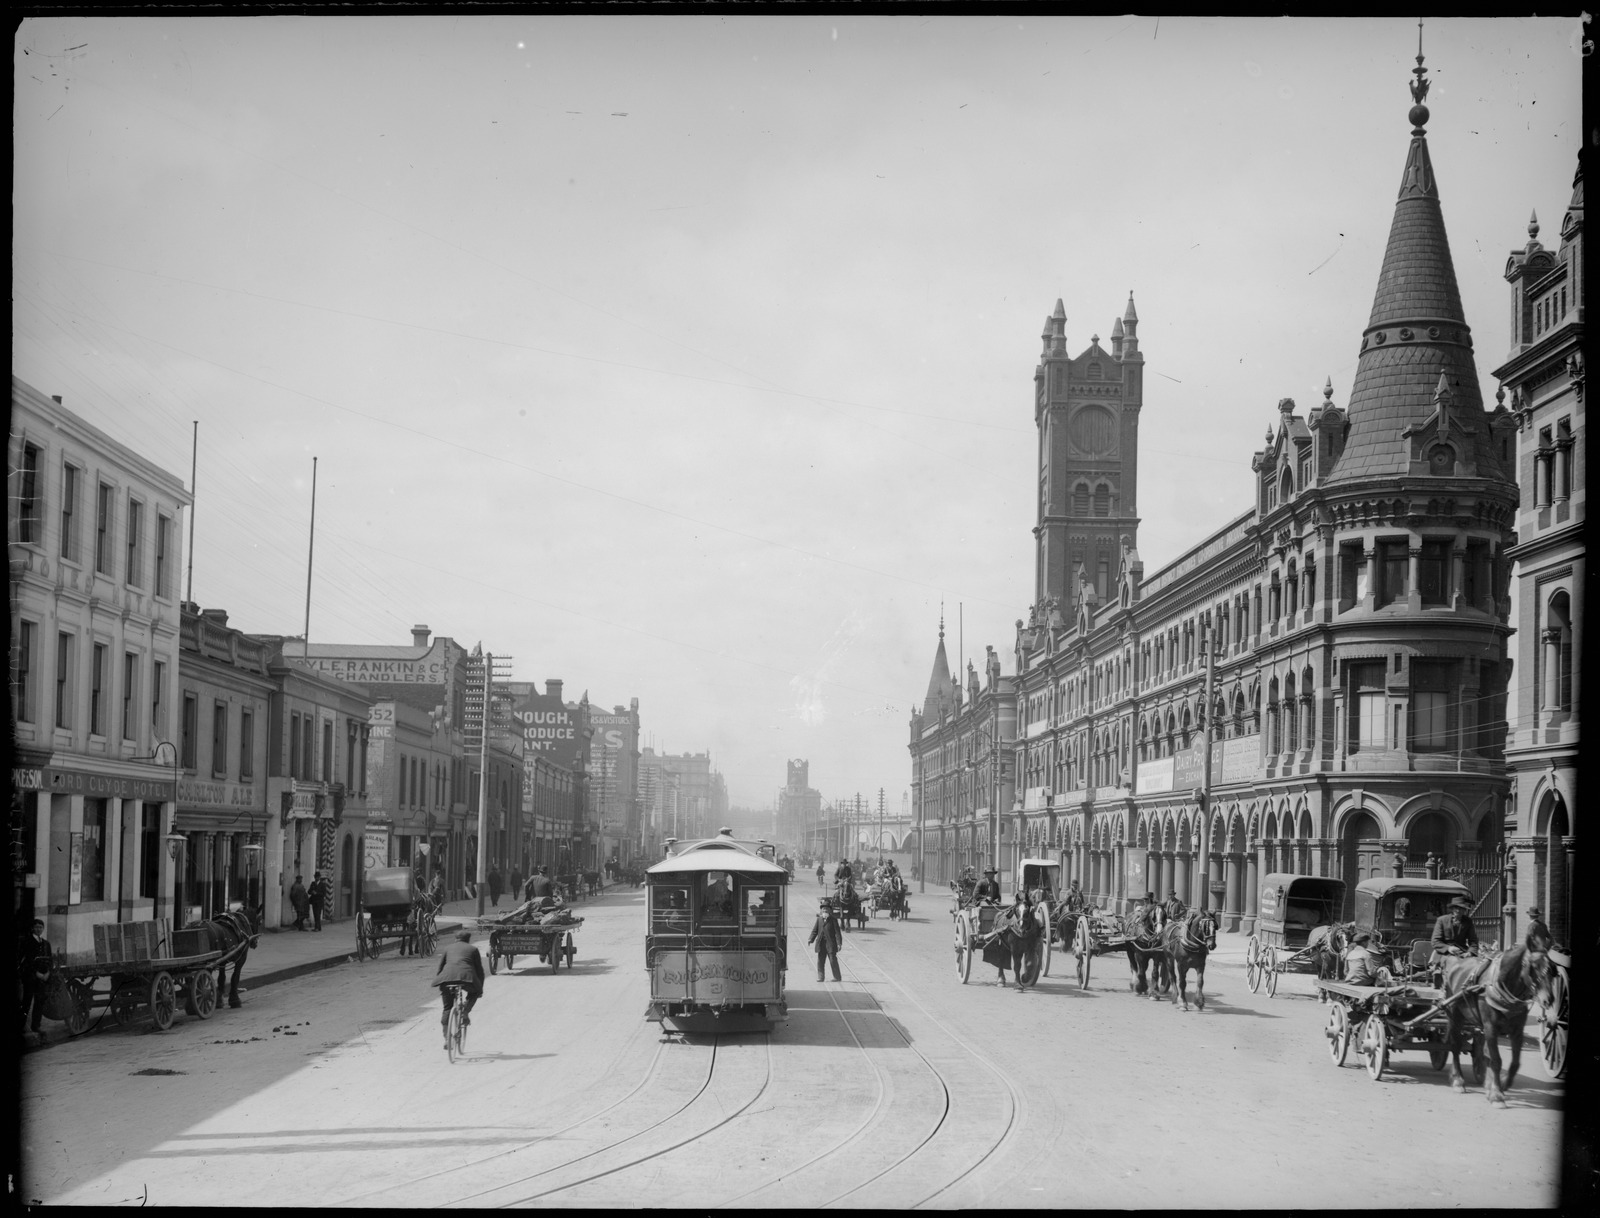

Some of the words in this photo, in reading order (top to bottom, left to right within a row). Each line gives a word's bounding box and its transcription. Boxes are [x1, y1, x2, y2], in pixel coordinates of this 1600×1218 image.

[347, 662, 414, 673] RANKIN
[418, 665, 426, 673] &
[335, 672, 441, 683] CHANDLERS.
[51, 771, 82, 790] LORD
[90, 776, 127, 794] CLYDE
[134, 782, 167, 798] HOTEL
[663, 964, 768, 985] RICHMOND
